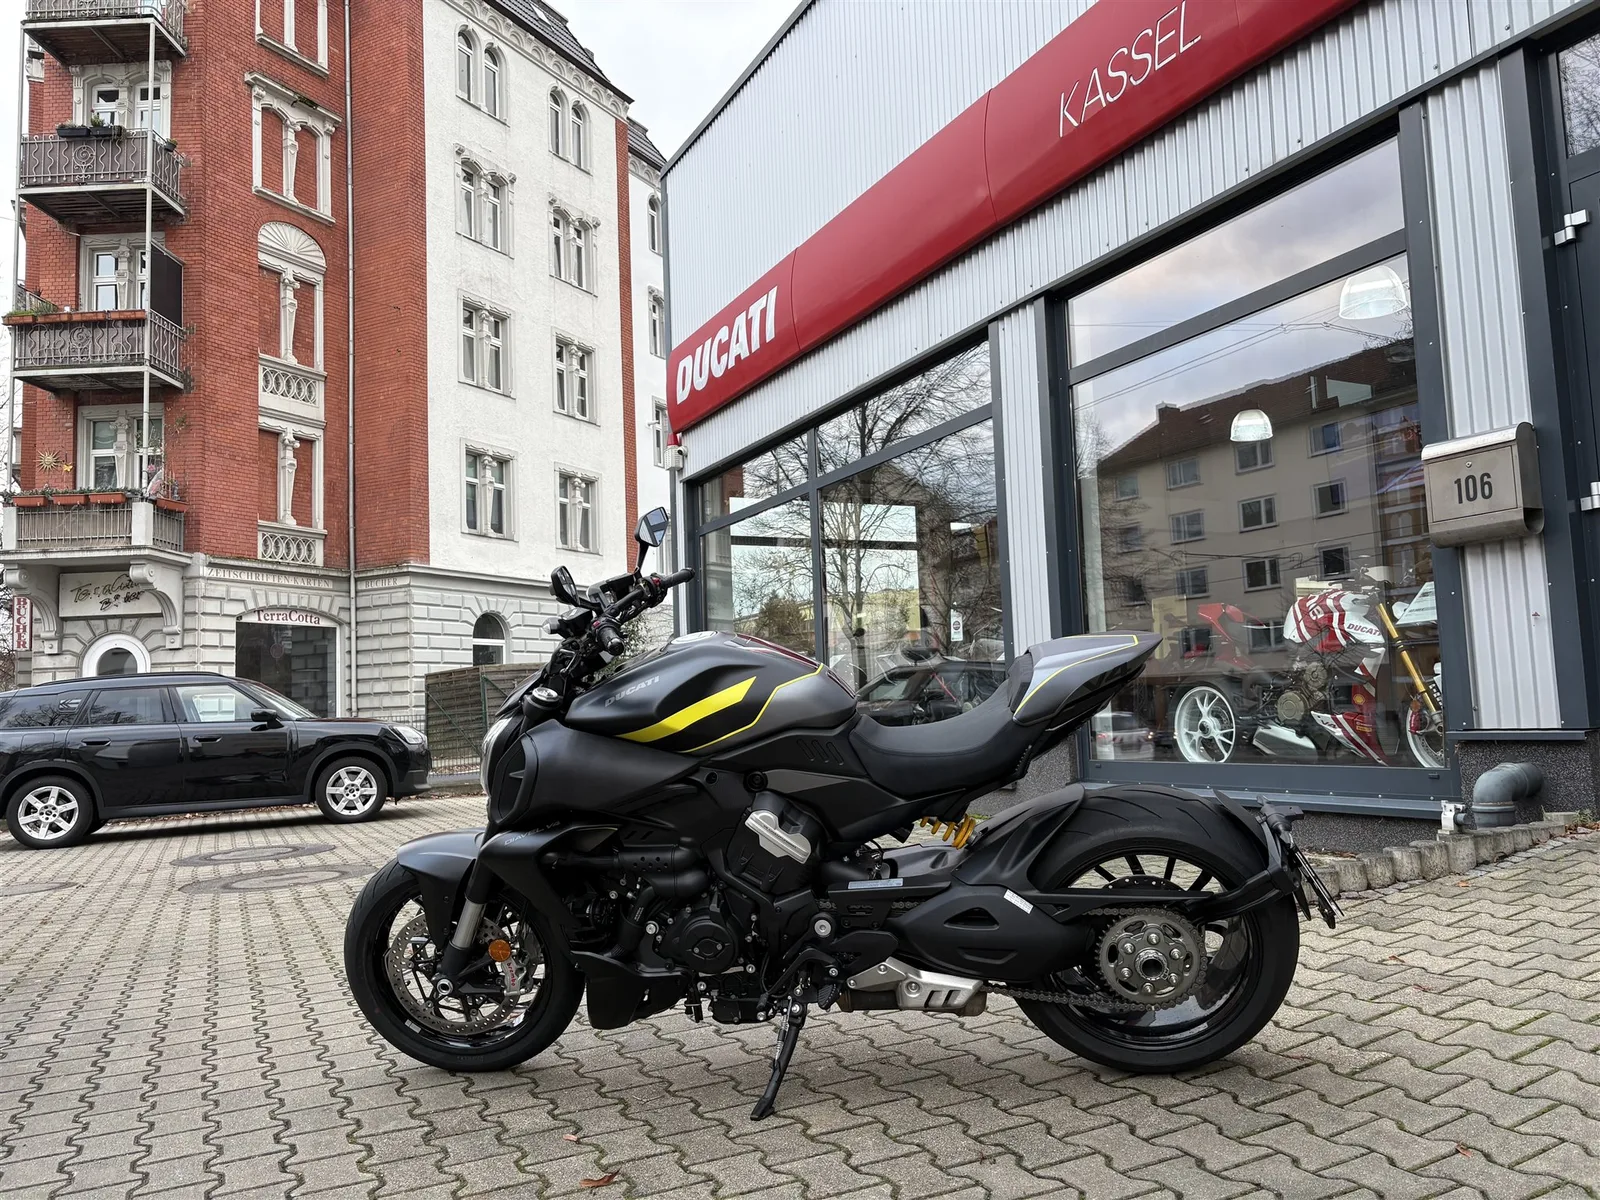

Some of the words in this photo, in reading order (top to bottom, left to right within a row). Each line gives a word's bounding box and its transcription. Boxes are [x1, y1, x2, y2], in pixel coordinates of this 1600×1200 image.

[1059, 0, 1202, 138] KASSEL
[676, 285, 778, 405] DUCATI
[1454, 472, 1493, 504] 106
[15, 597, 28, 649] BÜCHER
[253, 609, 321, 625] TerraCotta
[604, 675, 660, 708] DUCATI
[504, 827, 545, 846] DIAVEL
[506, 962, 517, 987] brembo
